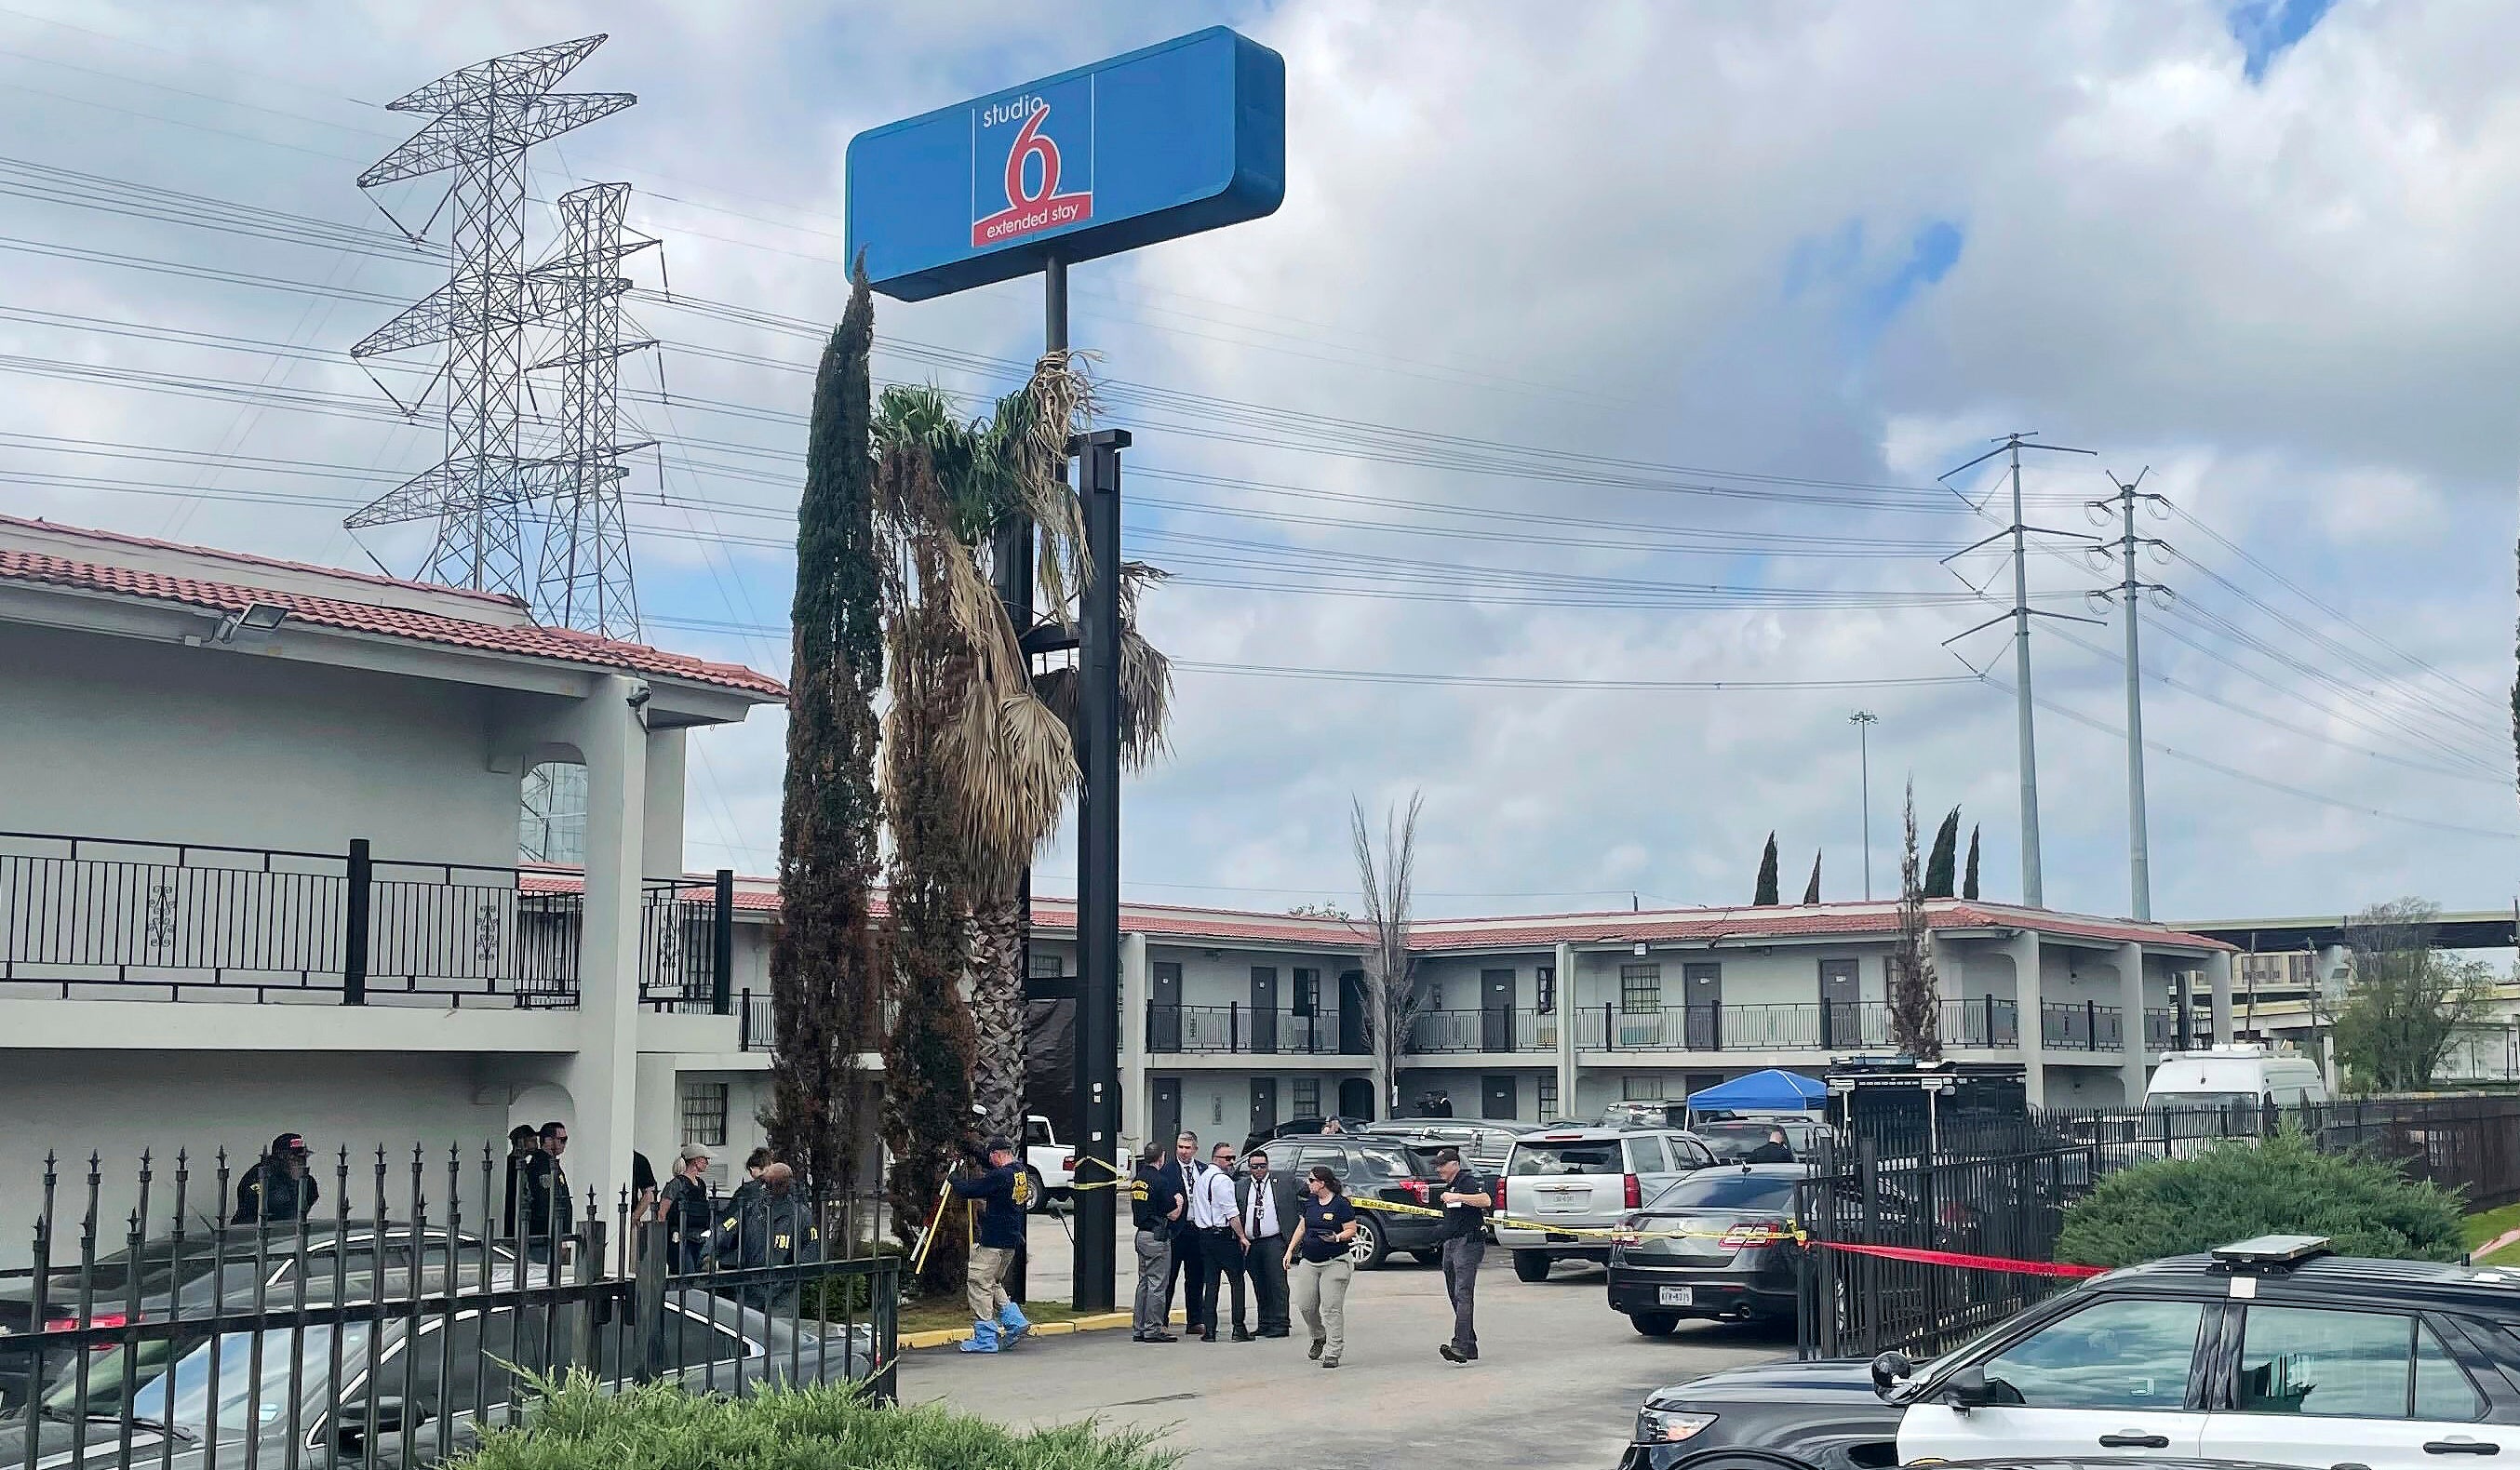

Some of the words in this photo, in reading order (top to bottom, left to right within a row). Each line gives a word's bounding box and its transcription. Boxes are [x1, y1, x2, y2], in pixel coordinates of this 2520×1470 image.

[983, 94, 1044, 128] studio
[1004, 104, 1062, 208] 6
[986, 209, 1048, 238] extended
[1052, 203, 1079, 221] stay
[774, 1235, 790, 1250] FBI
